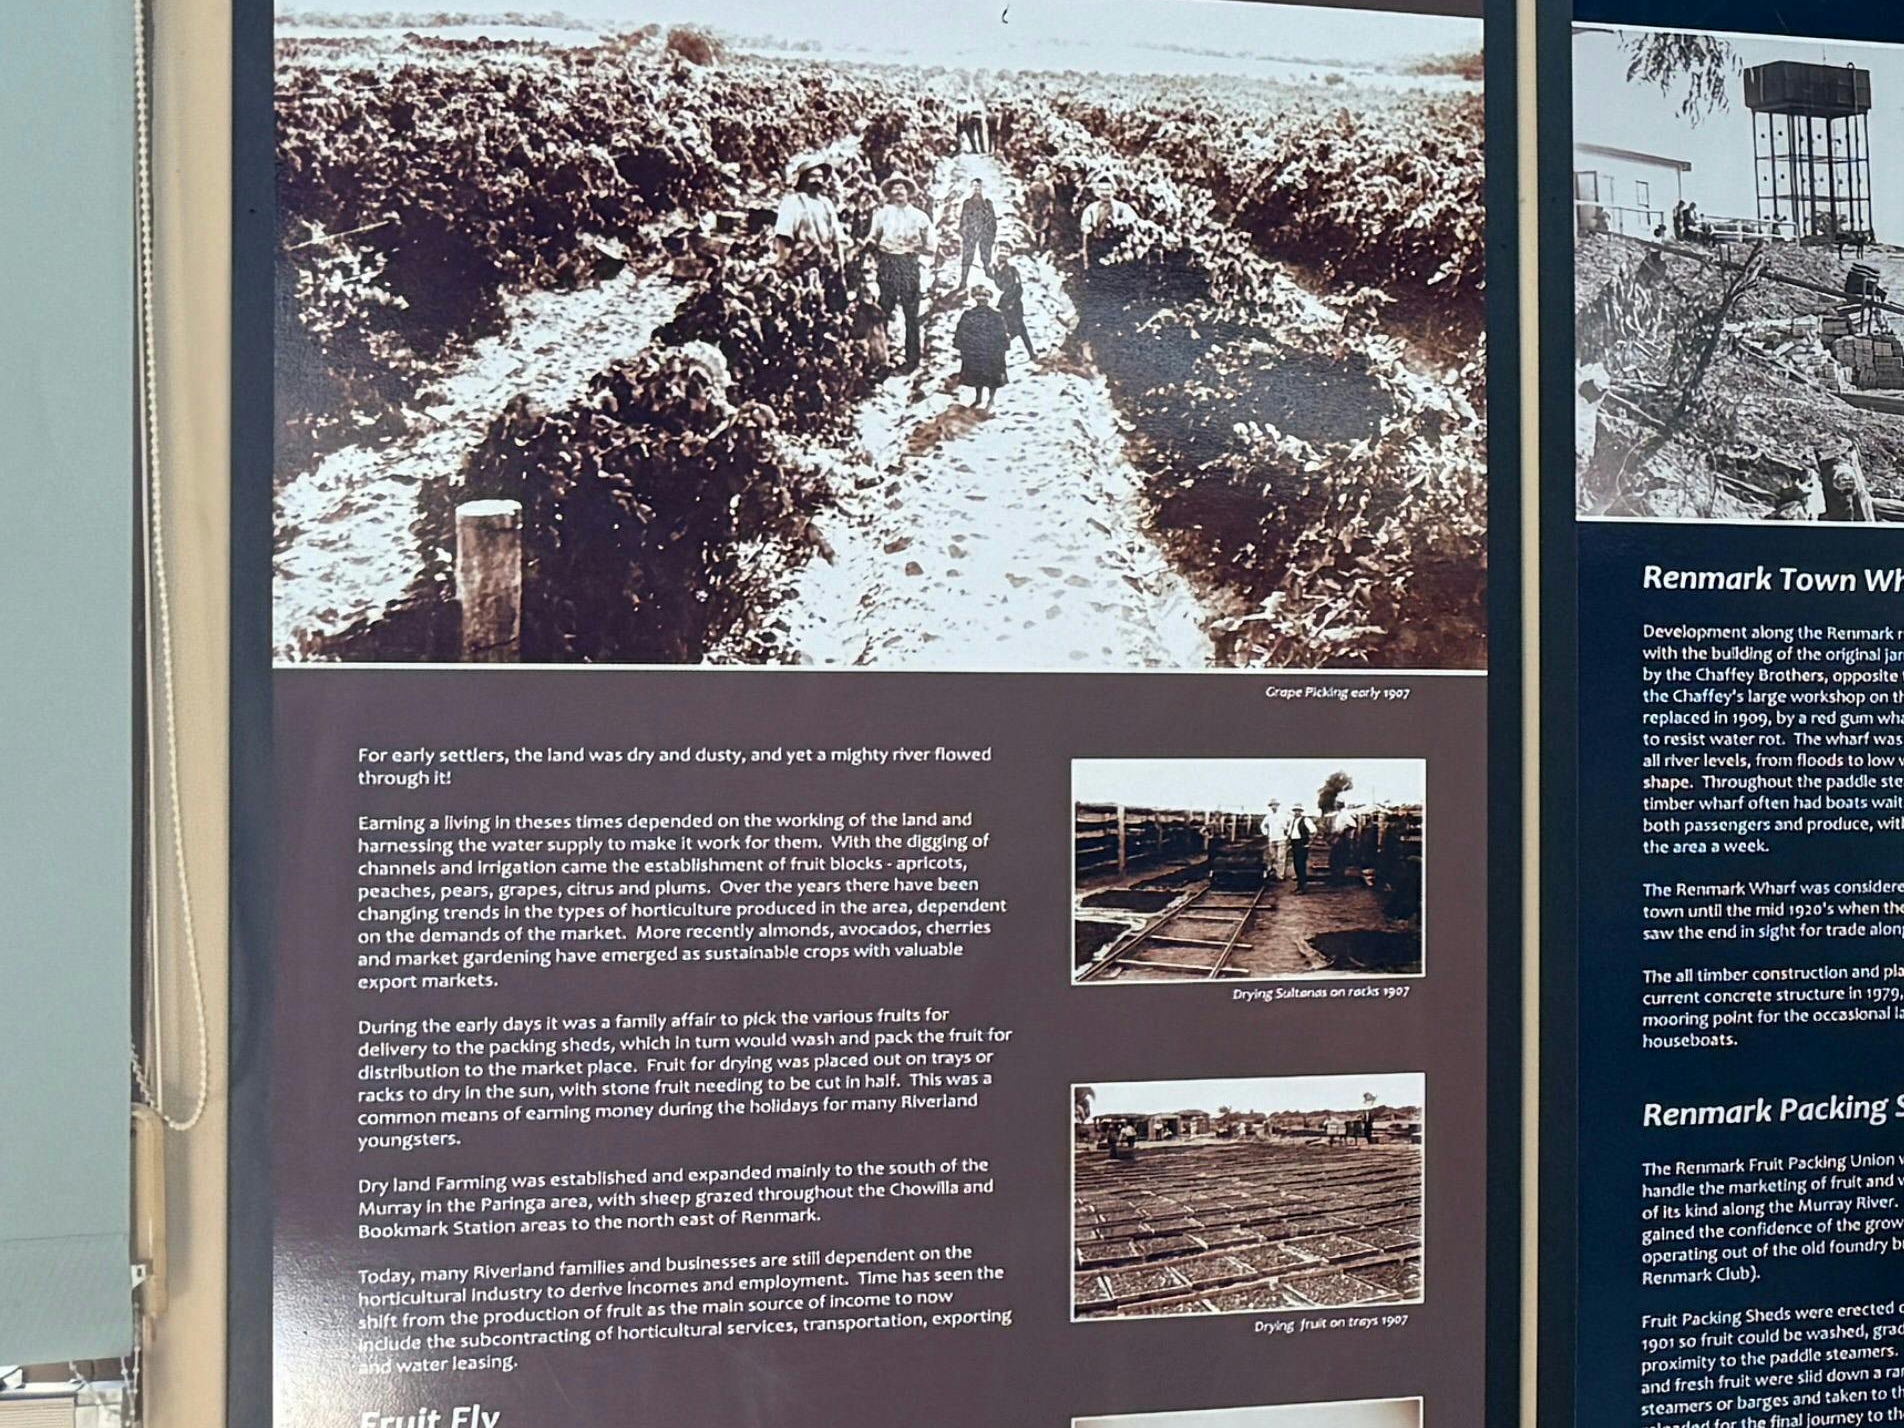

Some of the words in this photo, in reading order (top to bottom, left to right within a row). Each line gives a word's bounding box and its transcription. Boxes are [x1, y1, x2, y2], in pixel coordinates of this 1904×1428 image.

[1643, 564, 1772, 591] Renmark
[1779, 567, 1857, 592] Town
[1265, 686, 1303, 700] Grape
[1304, 686, 1349, 702] Picking
[1350, 686, 1381, 701] early
[1383, 688, 1411, 700] 1907
[1643, 839, 1670, 855] the
[1672, 842, 1707, 854] area
[1710, 842, 1720, 853] a
[1723, 838, 1770, 853] week.
[1232, 988, 1274, 1003] Drying
[1275, 987, 1328, 999] Sultanas
[1329, 988, 1346, 998] on
[1347, 985, 1380, 997] racks
[1383, 986, 1410, 999] 1907
[1643, 1097, 1772, 1127] Renmark
[1779, 1094, 1890, 1126] Packing
[1254, 1320, 1295, 1335] Drying
[1299, 1317, 1327, 1332] fruit
[1329, 1318, 1346, 1328] on
[1348, 1316, 1379, 1329] trays
[1381, 1314, 1409, 1328] 1907
